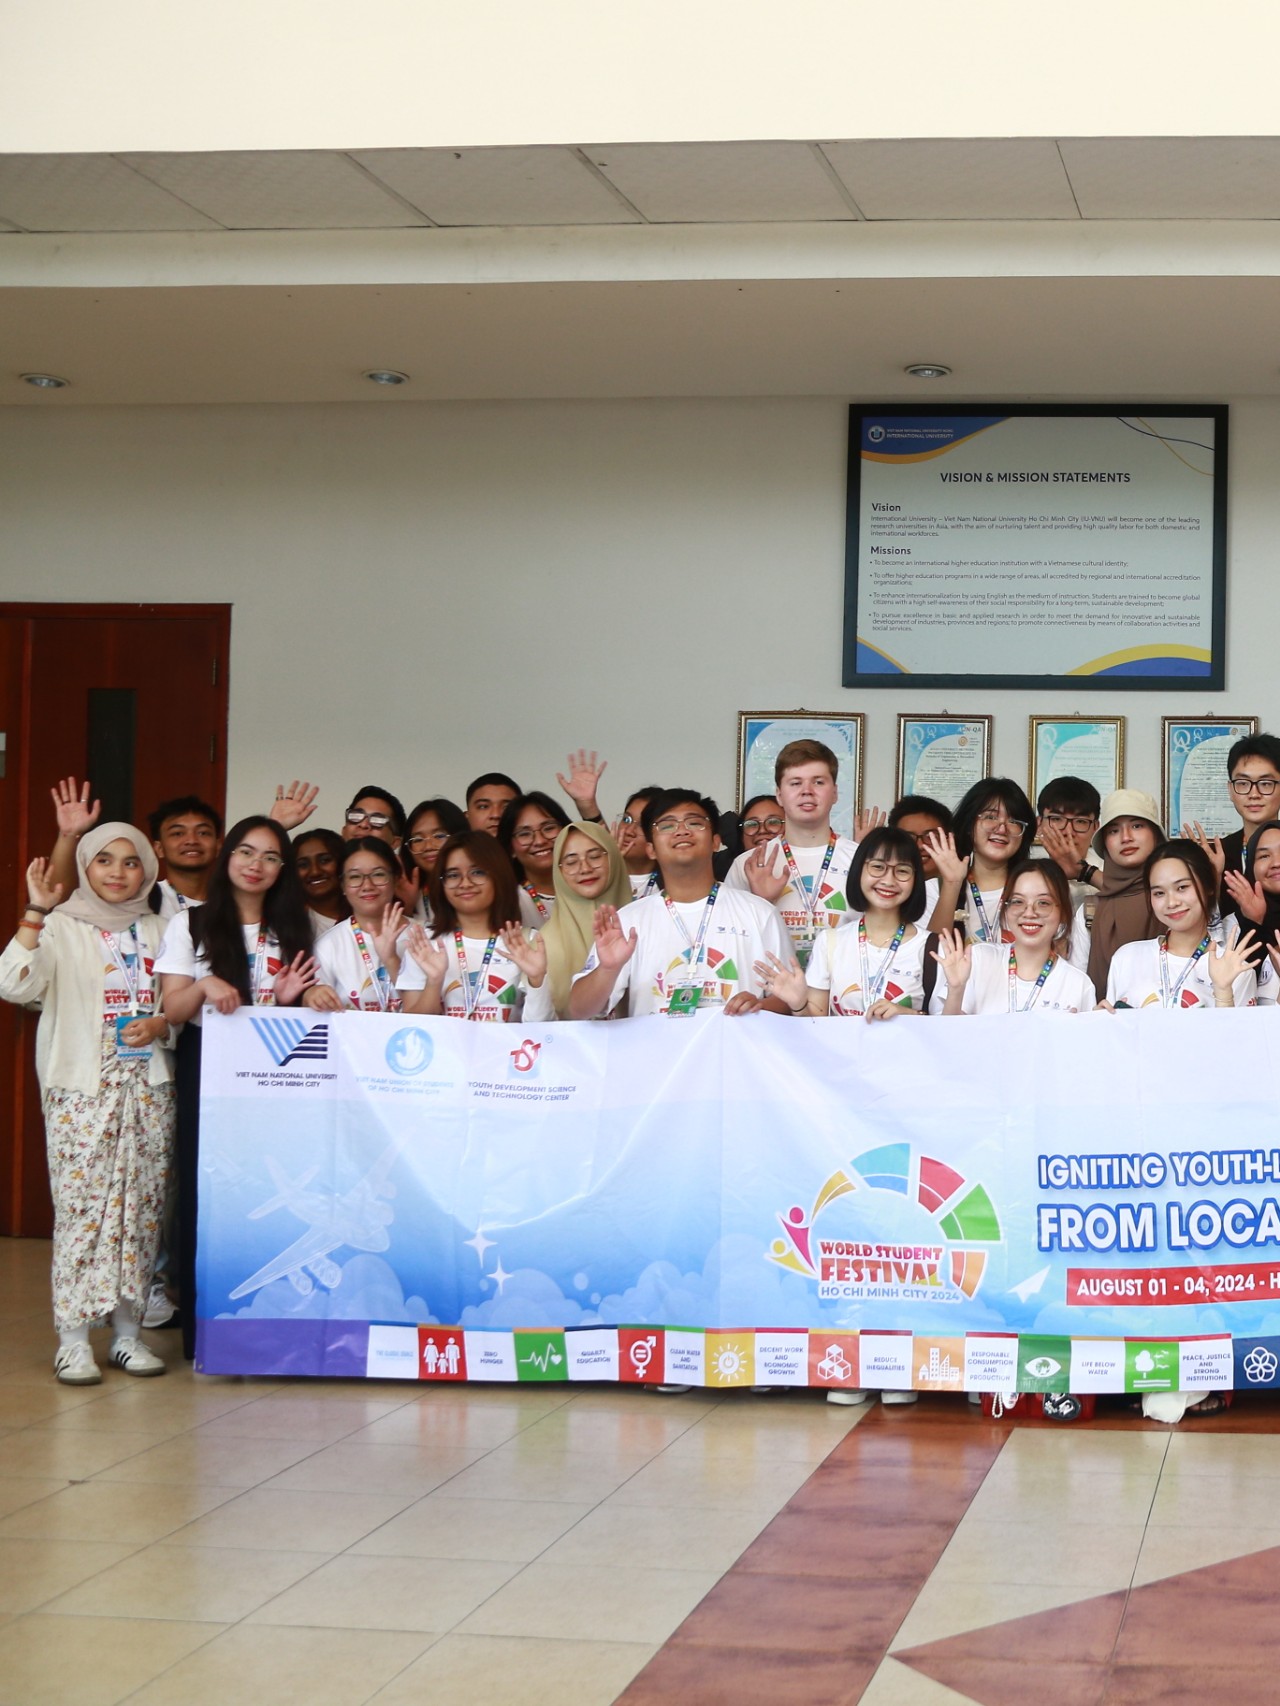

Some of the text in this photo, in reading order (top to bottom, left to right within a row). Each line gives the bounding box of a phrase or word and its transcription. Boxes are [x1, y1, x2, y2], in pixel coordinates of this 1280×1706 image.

[940, 473, 1131, 483] VISION & MISSION STATEMENTS
[872, 503, 901, 512] Vision
[871, 546, 911, 555] Missions
[468, 1081, 576, 1093] YOUTH DEVELOPMENT SCIENCE
[474, 1090, 570, 1101] AND TECHNOLOGY CENTER
[1039, 1153, 1166, 1189] IGNITING
[1037, 1202, 1157, 1253] FROM
[821, 1241, 943, 1261] WORLD STUDENT
[821, 1258, 943, 1287] FESTIVAL
[1077, 1278, 1144, 1297] AUGUST
[1147, 1277, 1168, 1296] 01
[1184, 1275, 1211, 1296] 04,
[1214, 1273, 1256, 1293] 2024
[821, 1286, 960, 1300] HO CHI MINH CITY 2024
[576, 1356, 611, 1364] EDUCATION
